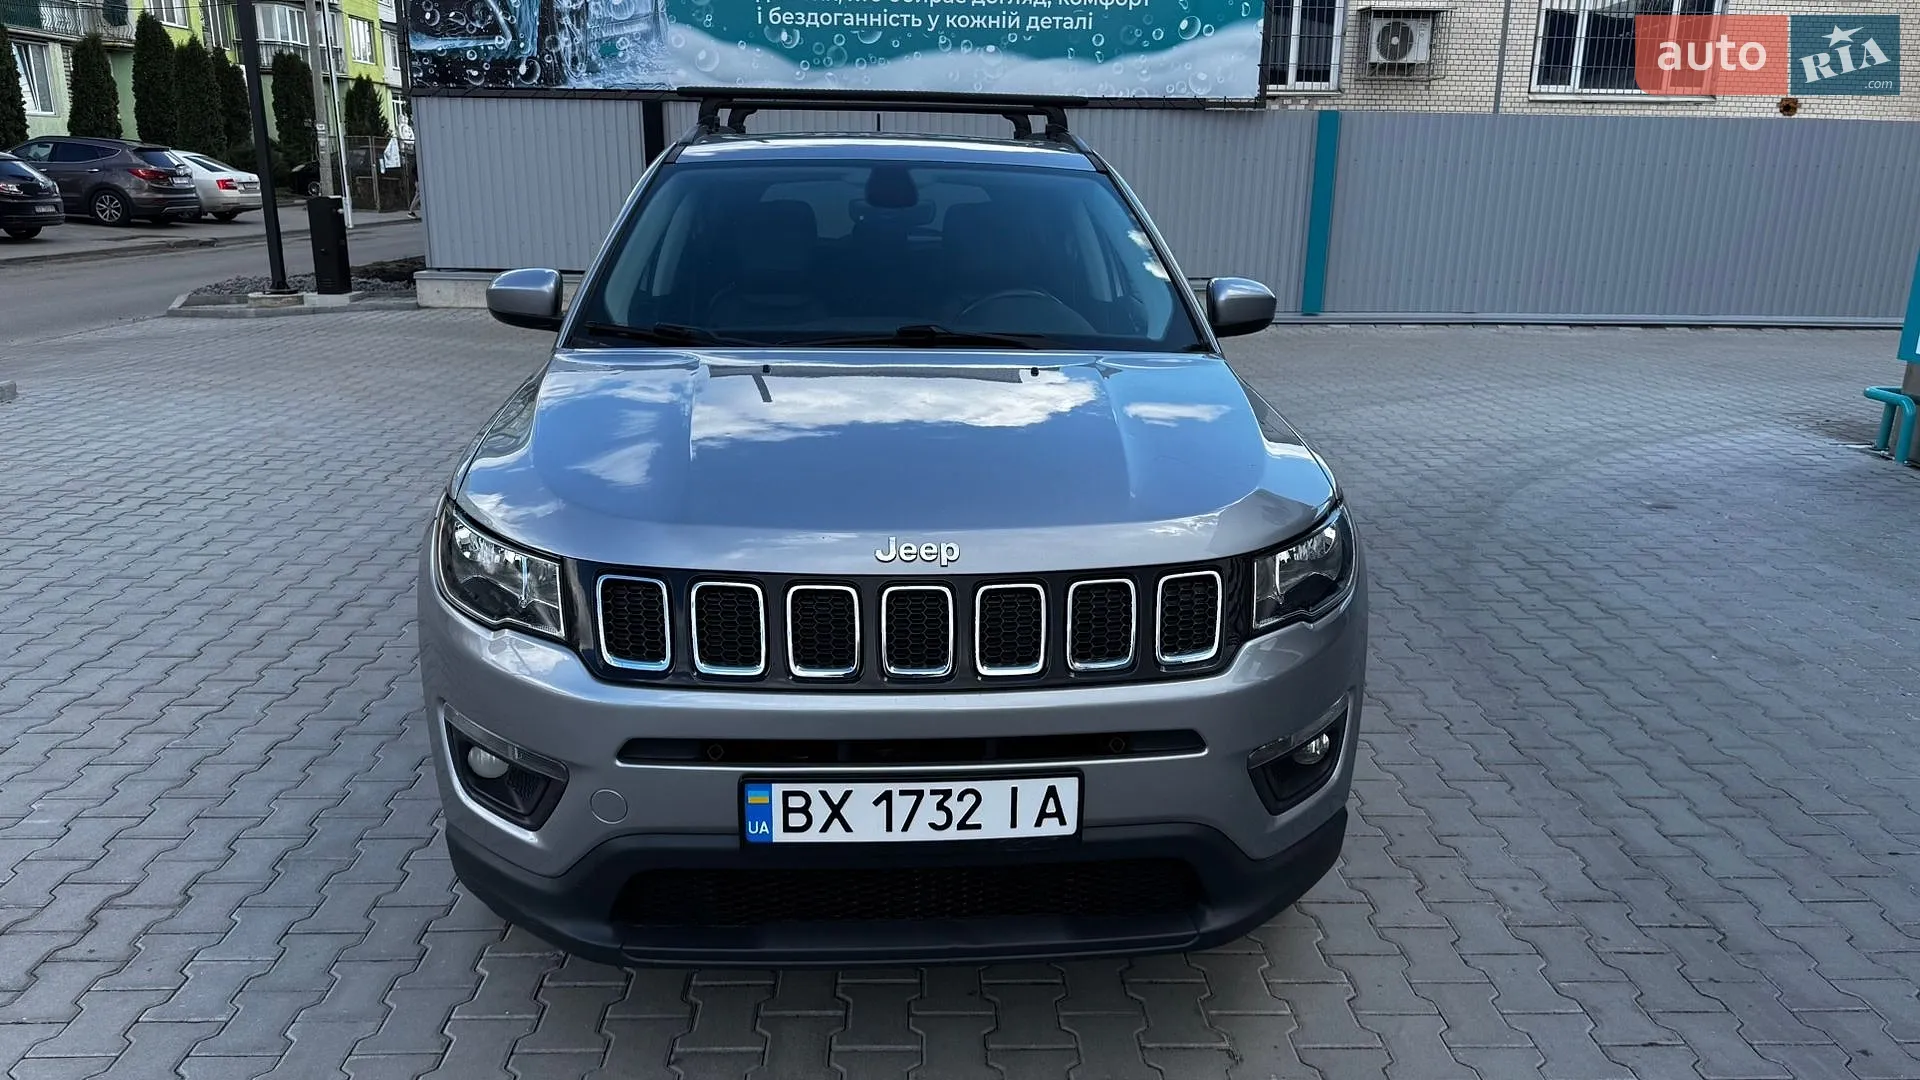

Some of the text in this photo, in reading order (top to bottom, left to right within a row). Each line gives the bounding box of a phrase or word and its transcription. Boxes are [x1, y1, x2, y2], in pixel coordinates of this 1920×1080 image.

[757, 6, 1093, 31] і бездоганність у кожній деталі
[875, 536, 960, 567] Jeep
[781, 789, 854, 833] BX
[872, 788, 983, 832] 1732
[748, 821, 769, 835] UA
